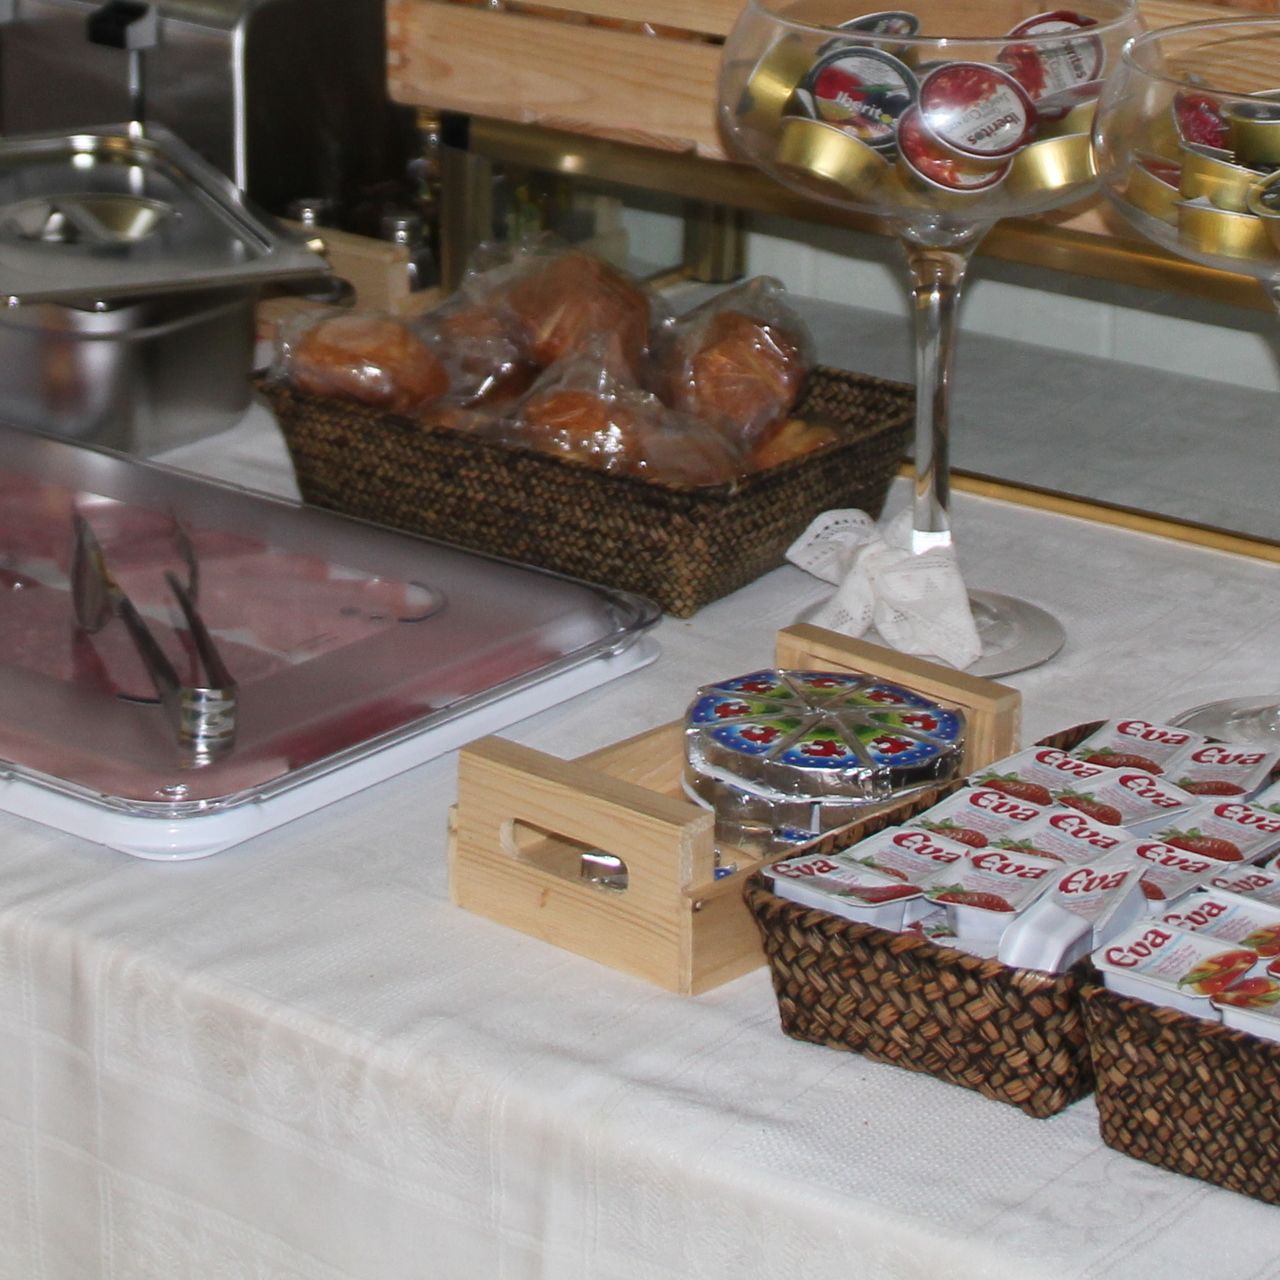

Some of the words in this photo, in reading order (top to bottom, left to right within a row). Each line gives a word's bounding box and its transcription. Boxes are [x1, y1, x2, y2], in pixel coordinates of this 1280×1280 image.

[967, 111, 1019, 145] Iberitos
[1117, 720, 1191, 745] Eva
[1035, 750, 1104, 778] Eva
[1191, 746, 1267, 765] Eva
[969, 790, 1040, 822] Eva
[1119, 774, 1183, 808] Eva
[1050, 814, 1120, 849] Eva
[893, 832, 962, 863] Eva
[1136, 843, 1211, 873] Eva
[771, 859, 839, 879] Eva
[972, 852, 1048, 879] Eva
[1059, 868, 1130, 894] Eva
[1105, 928, 1172, 968] Eva
